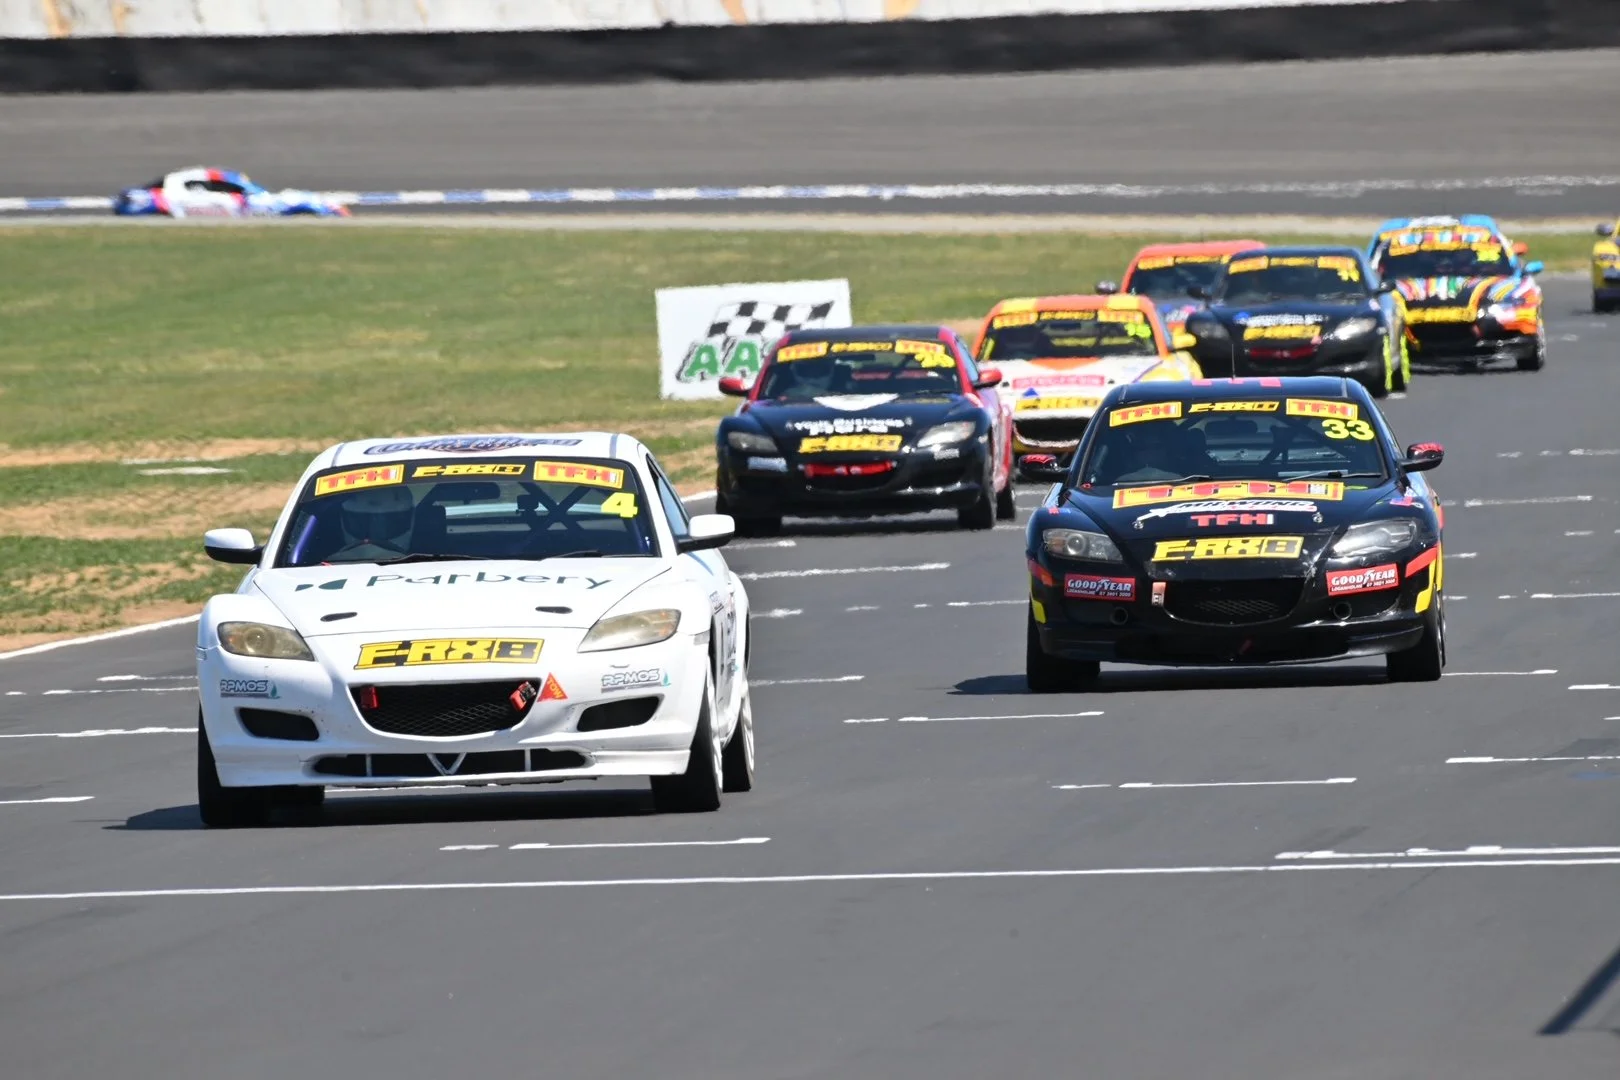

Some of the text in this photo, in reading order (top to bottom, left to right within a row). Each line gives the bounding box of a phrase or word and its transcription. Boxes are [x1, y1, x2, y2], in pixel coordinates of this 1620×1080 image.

[676, 336, 774, 380] AA
[1116, 403, 1174, 421] TFH
[1292, 401, 1351, 416] TFH
[1321, 419, 1375, 441] 33
[323, 467, 394, 489] TFH
[541, 464, 614, 483] TFH
[600, 492, 638, 518] 4
[1190, 513, 1271, 527] TFH
[366, 571, 613, 590] Parbery
[219, 679, 269, 693] RPMOS
[601, 669, 660, 687] RPMOS
[548, 678, 565, 699] TOW
